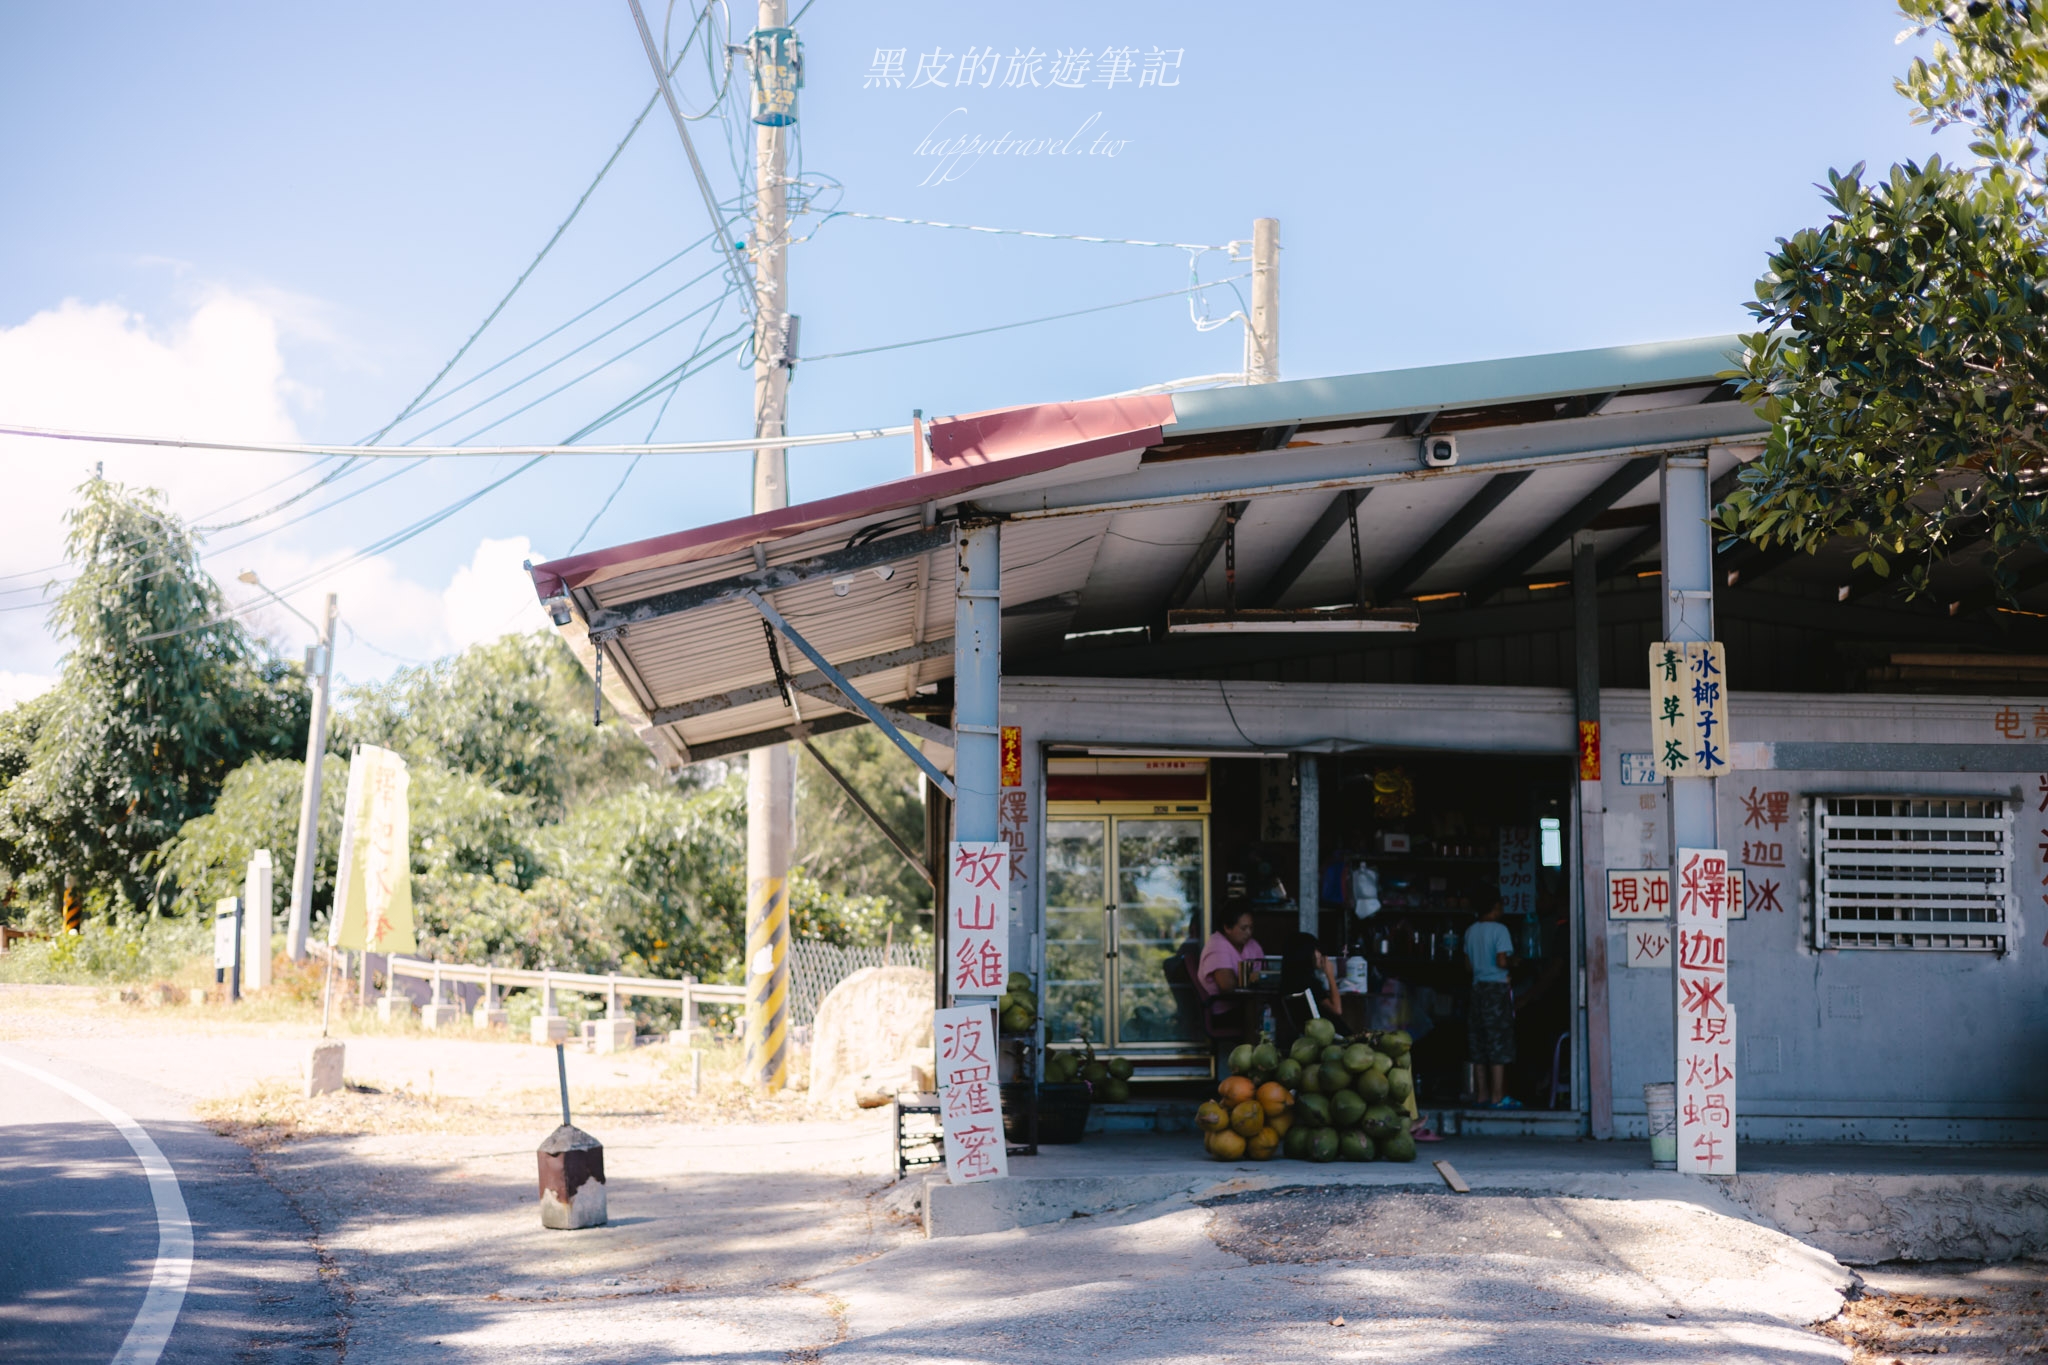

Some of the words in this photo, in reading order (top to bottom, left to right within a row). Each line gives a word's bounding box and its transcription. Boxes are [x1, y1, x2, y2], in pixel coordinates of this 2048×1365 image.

[1656, 650, 1690, 770] 青草茶
[1690, 649, 1725, 770] 冰椰子水
[1639, 770, 1655, 783] 78
[1740, 786, 1790, 912] 釋迦冰
[955, 846, 1006, 989] 放山雞
[1680, 853, 1725, 1018] 釋迦冰
[943, 1016, 998, 1178] 波羅蜜
